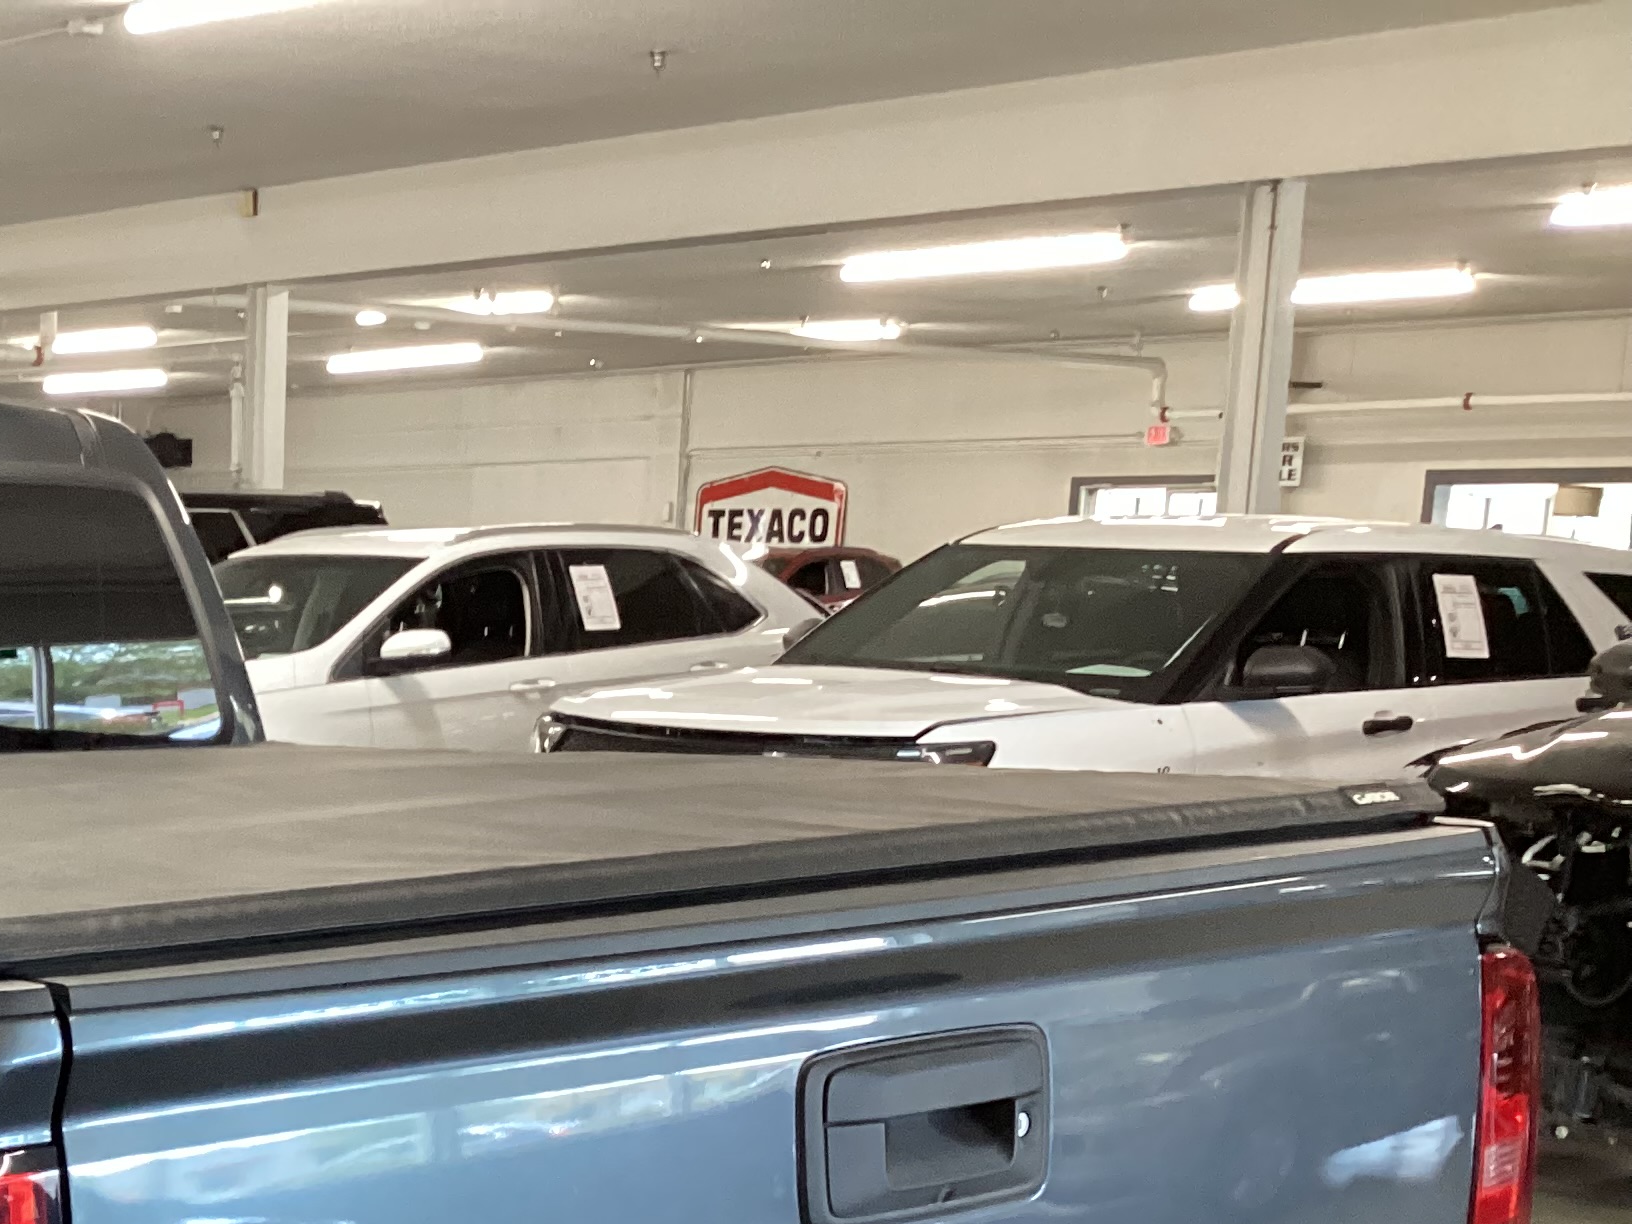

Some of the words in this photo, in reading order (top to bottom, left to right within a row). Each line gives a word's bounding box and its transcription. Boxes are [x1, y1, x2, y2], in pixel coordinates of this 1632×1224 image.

[1281, 442, 1300, 452] RS
[1282, 455, 1294, 466] R
[1279, 469, 1297, 481] LE
[707, 508, 830, 544] TEXACO
